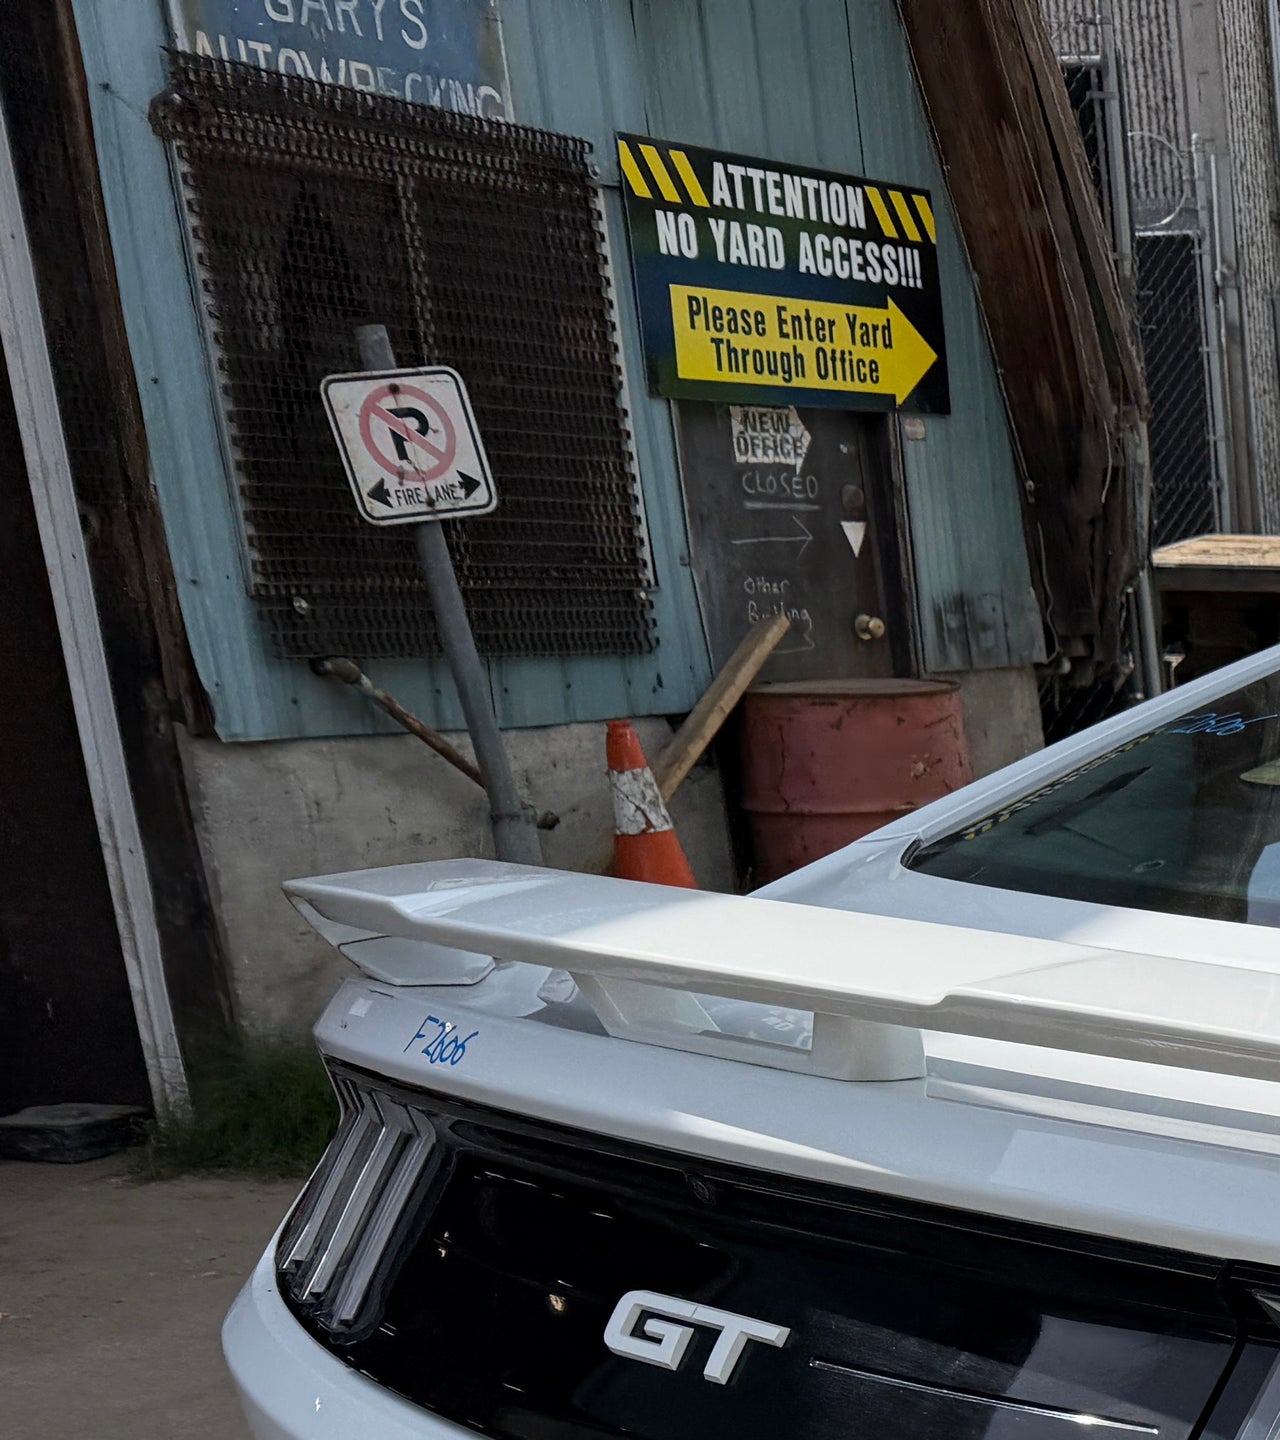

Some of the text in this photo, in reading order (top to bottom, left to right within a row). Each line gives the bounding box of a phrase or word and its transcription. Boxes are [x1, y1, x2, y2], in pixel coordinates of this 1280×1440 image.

[711, 161, 867, 230] ATTENTION
[655, 209, 923, 289] NO YARD ACCESS!!!
[686, 295, 893, 350] Please Enter Yard
[710, 337, 880, 384] Through Office
[736, 431, 805, 460] OFFICE
[743, 410, 790, 433] NEW
[394, 486, 425, 507] FIRE
[741, 470, 819, 499] CLOSED
[403, 1015, 480, 1066] F2606
[603, 1289, 792, 1386] GT
